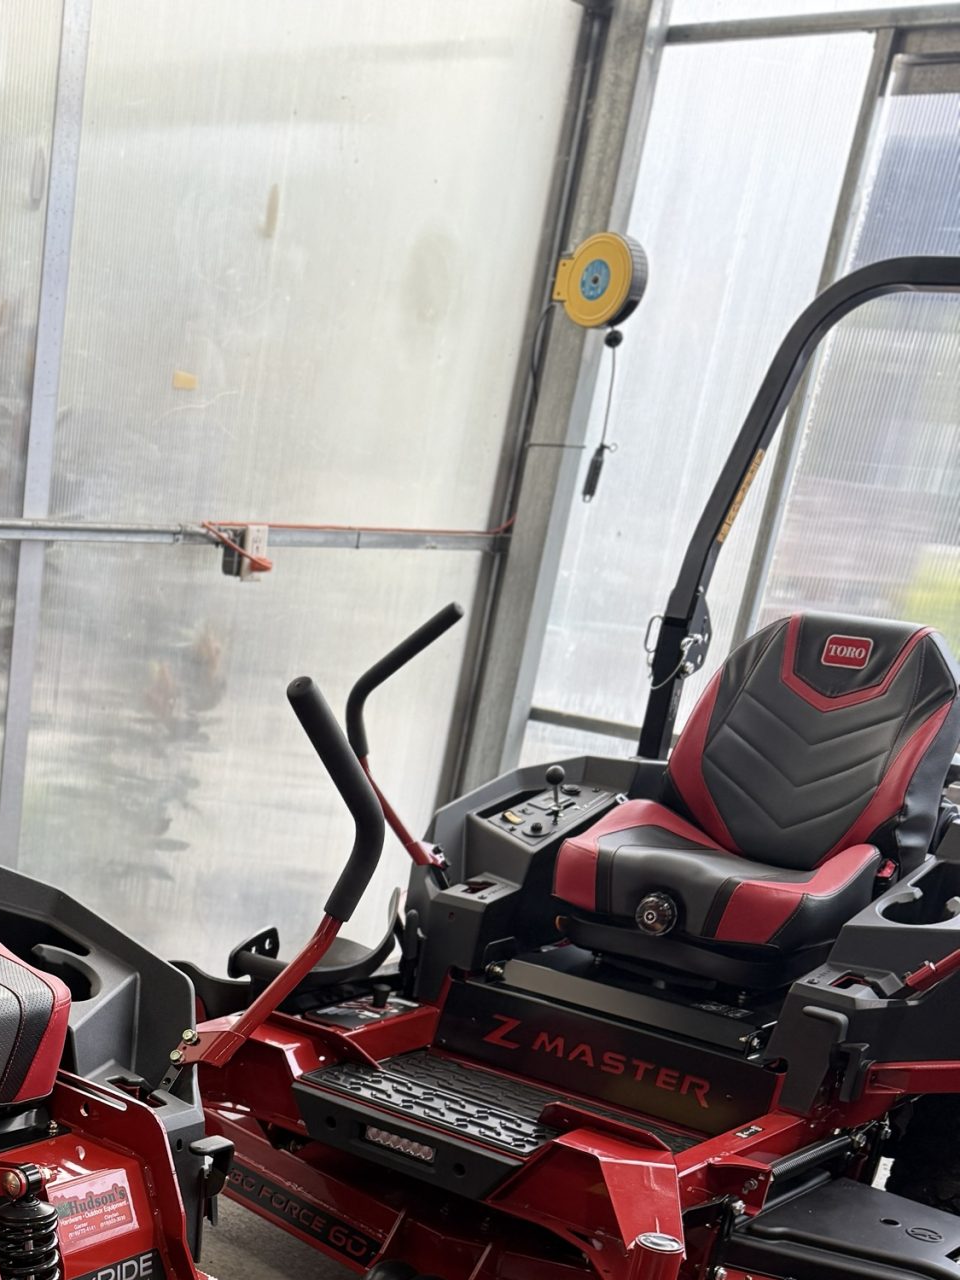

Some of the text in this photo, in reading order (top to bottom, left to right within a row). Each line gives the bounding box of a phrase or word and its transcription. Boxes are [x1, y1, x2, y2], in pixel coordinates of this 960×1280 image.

[828, 645, 866, 659] TORO
[483, 1014, 712, 1108] Z MASTER
[68, 1186, 126, 1216] Hudson's
[257, 1184, 327, 1233] FORCE
[327, 1225, 368, 1257] 60
